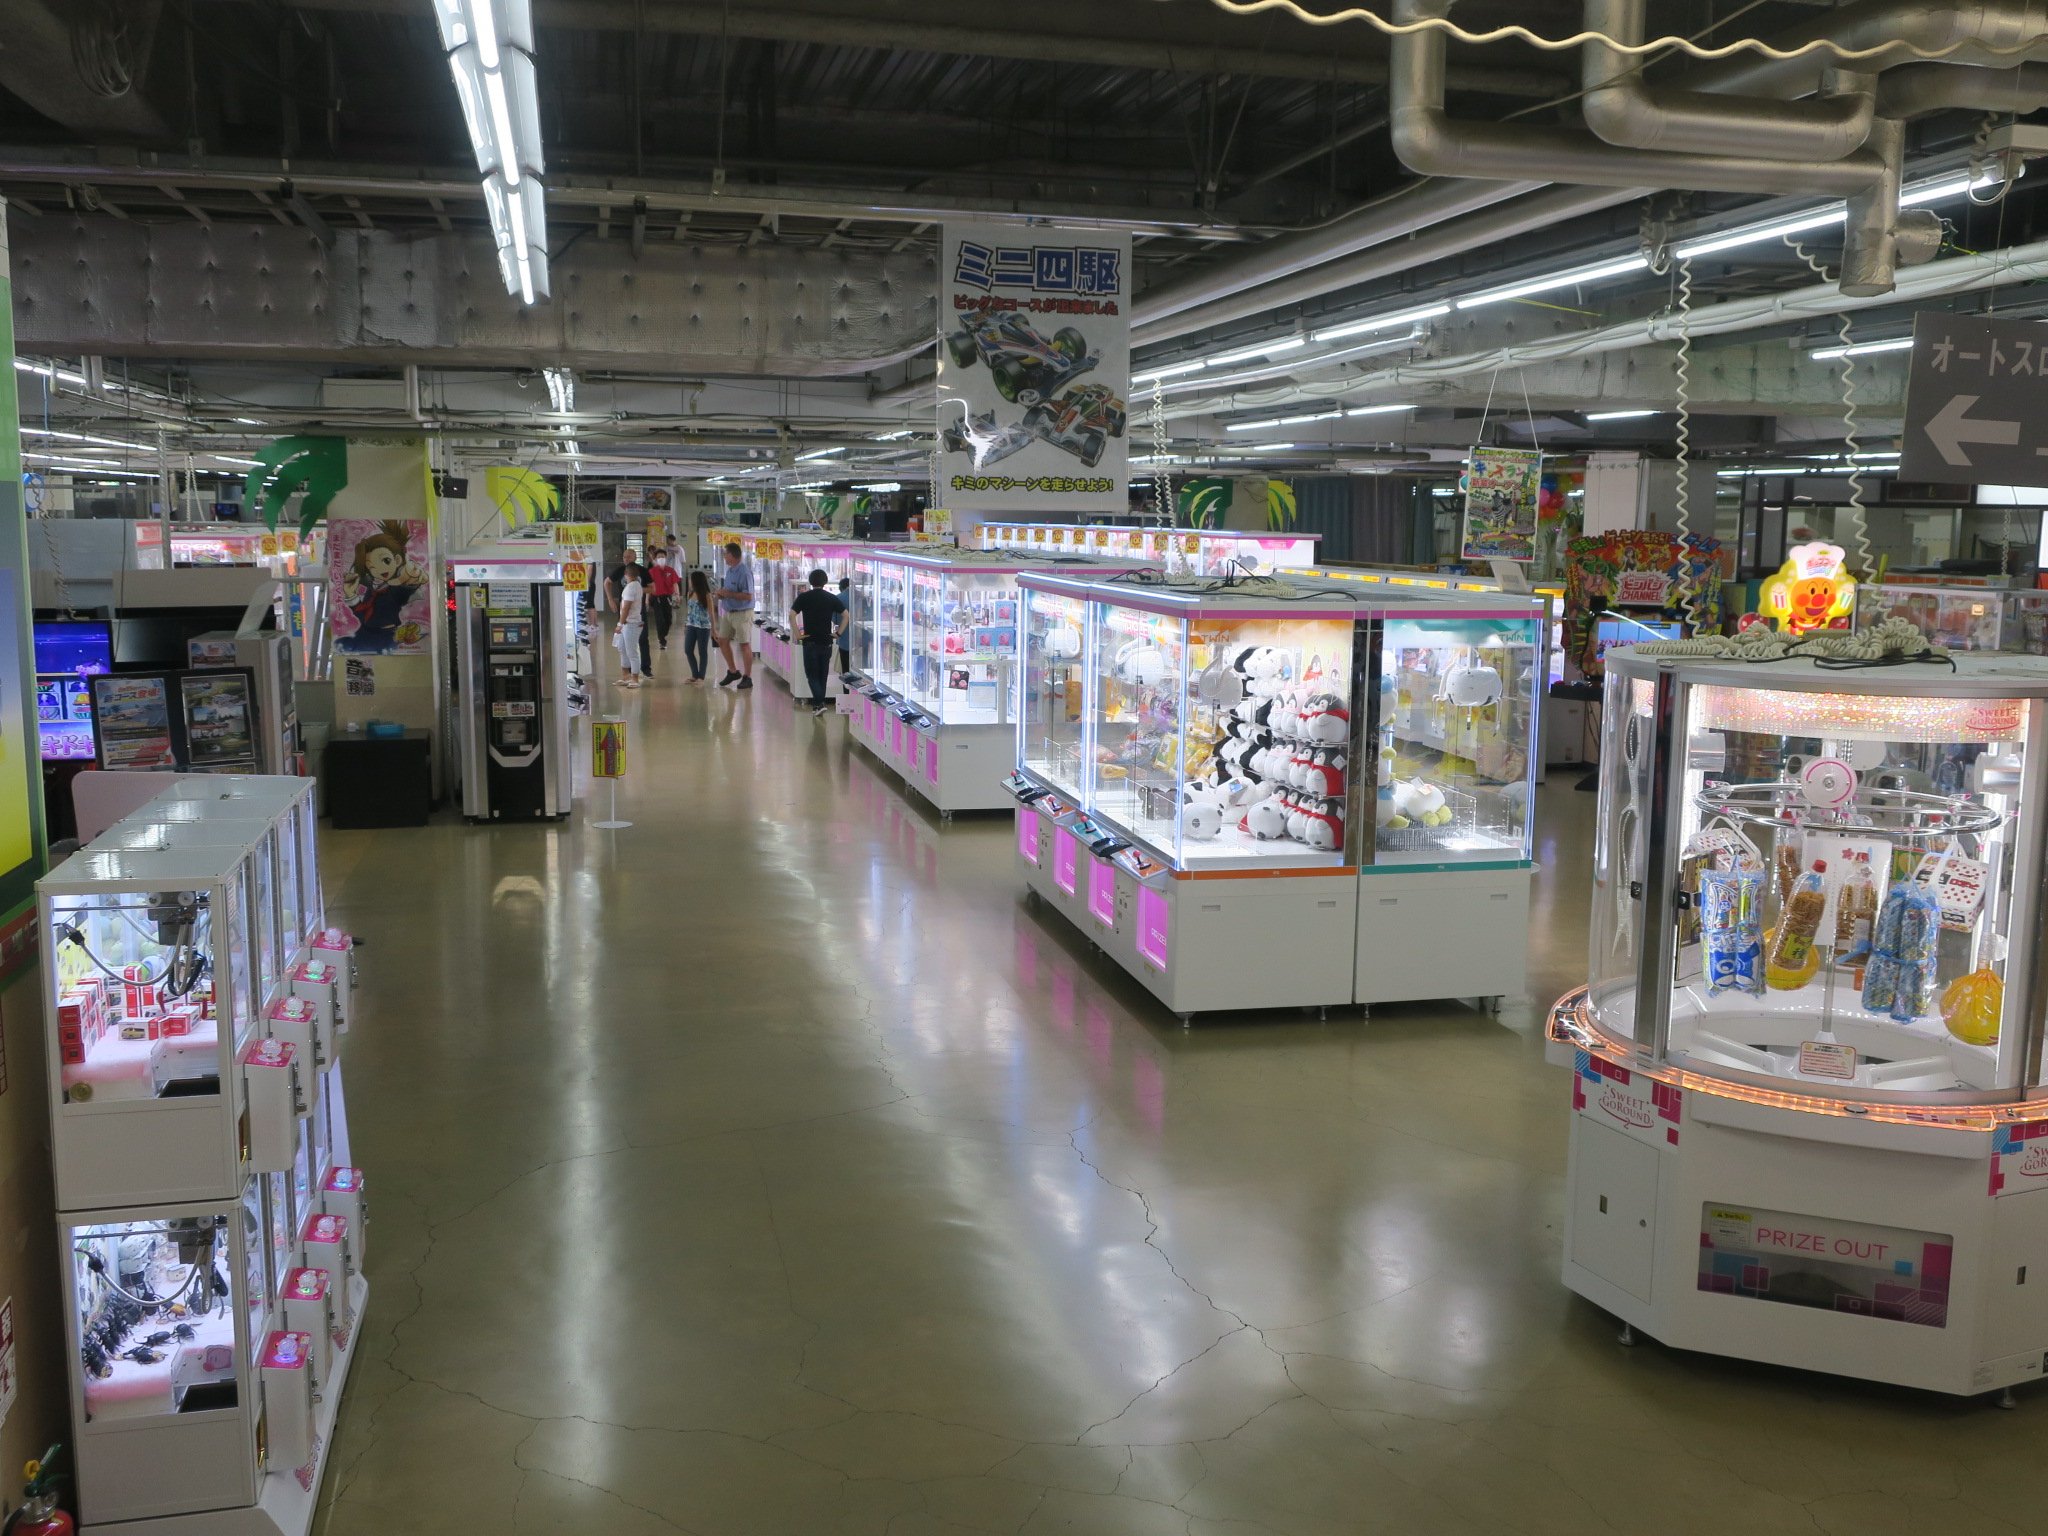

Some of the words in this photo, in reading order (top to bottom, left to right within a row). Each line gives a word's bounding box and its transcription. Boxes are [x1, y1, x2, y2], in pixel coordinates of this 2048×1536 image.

[954, 241, 1121, 295] ミニ四駆
[951, 475, 1114, 493] キミのマシーンを走らせよう!
[564, 570, 584, 582] 100
[1621, 590, 1661, 601] CHANNEL
[1201, 633, 1230, 643] TWIN
[1498, 633, 1525, 642] TWIN
[1978, 708, 2012, 716] SWEET
[1610, 1088, 1645, 1110] SWEET
[1757, 1228, 1826, 1252] PRIZE
[1834, 1239, 1889, 1260] OUT
